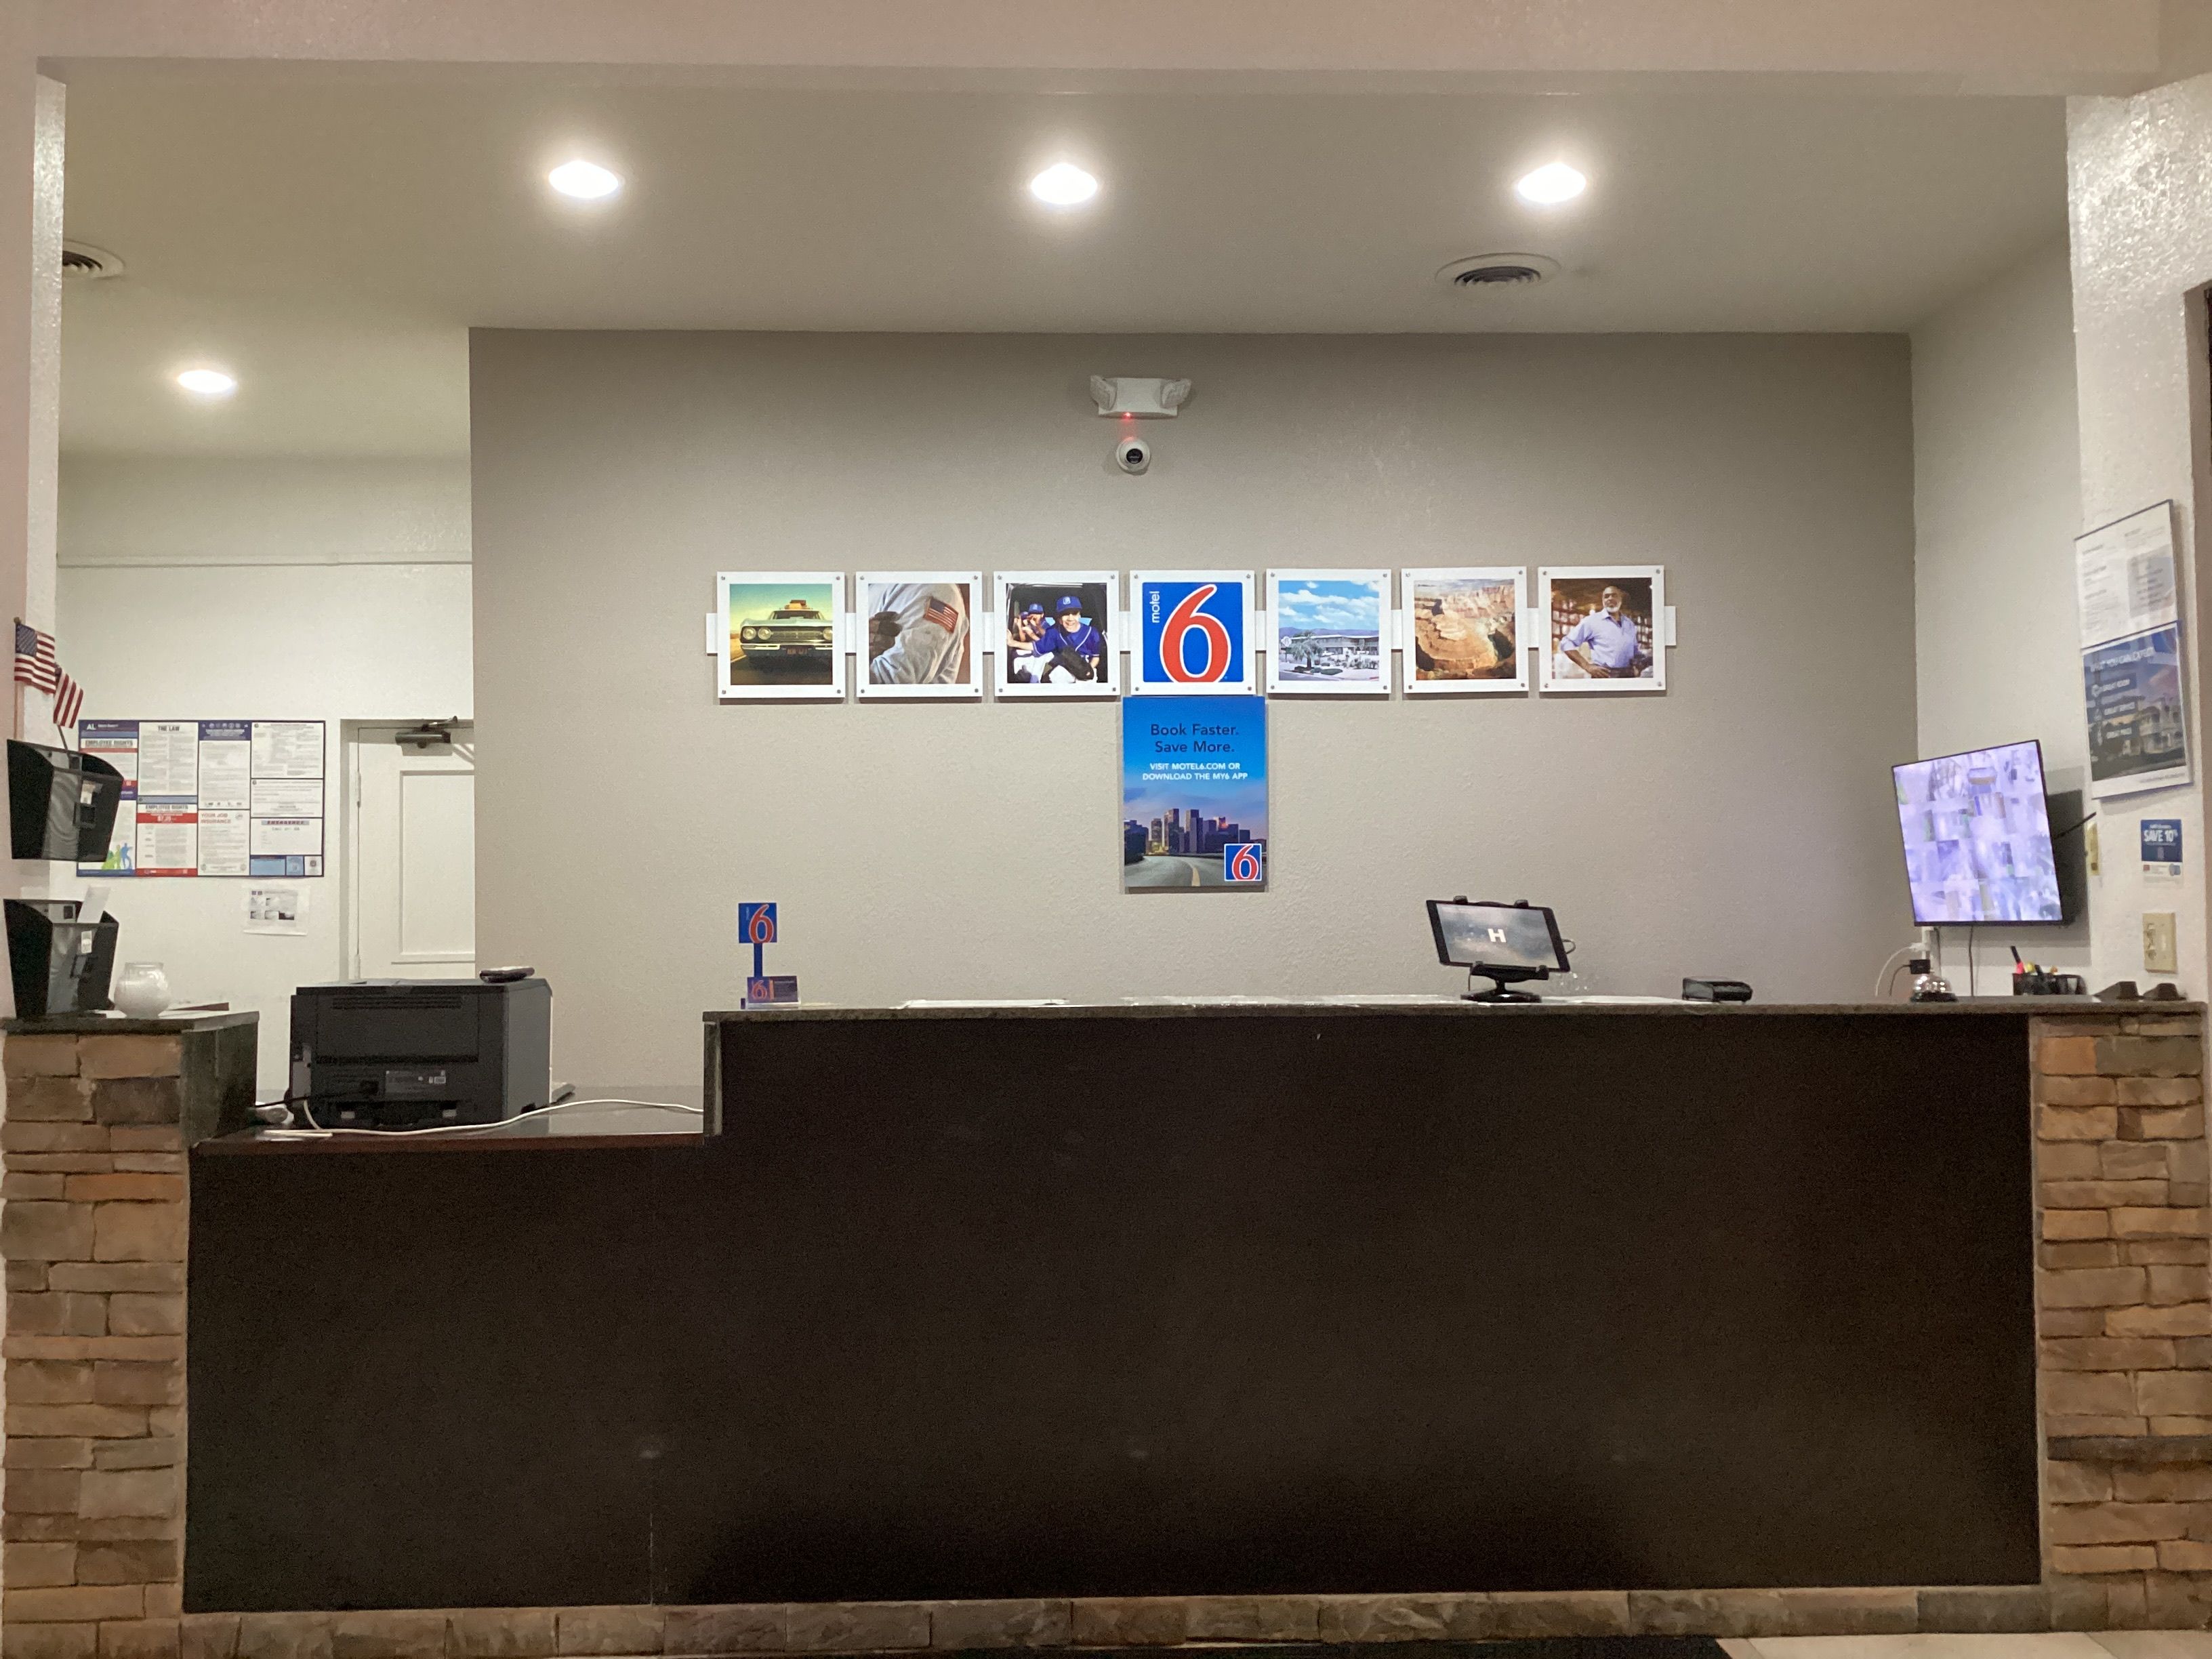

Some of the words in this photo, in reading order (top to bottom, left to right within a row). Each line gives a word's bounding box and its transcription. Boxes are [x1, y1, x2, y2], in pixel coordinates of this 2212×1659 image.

[1149, 591, 1160, 623] motel
[1160, 584, 1231, 682] 6
[1151, 723, 1187, 736] Book
[1192, 723, 1240, 736] Faster.
[1155, 741, 1188, 753] Save
[1193, 741, 1235, 753] More.
[1149, 762, 1169, 771] VISIT
[1172, 762, 1226, 771] MOTEL6.COM
[1142, 773, 1192, 781] DOWNLOAD
[1212, 772, 1230, 780] MY6
[1232, 772, 1248, 780] APP
[2144, 830, 2164, 842] SAVE
[1231, 844, 1259, 881] 6
[748, 904, 774, 943] 6
[1488, 928, 1507, 943] H
[752, 979, 768, 1000] 6
